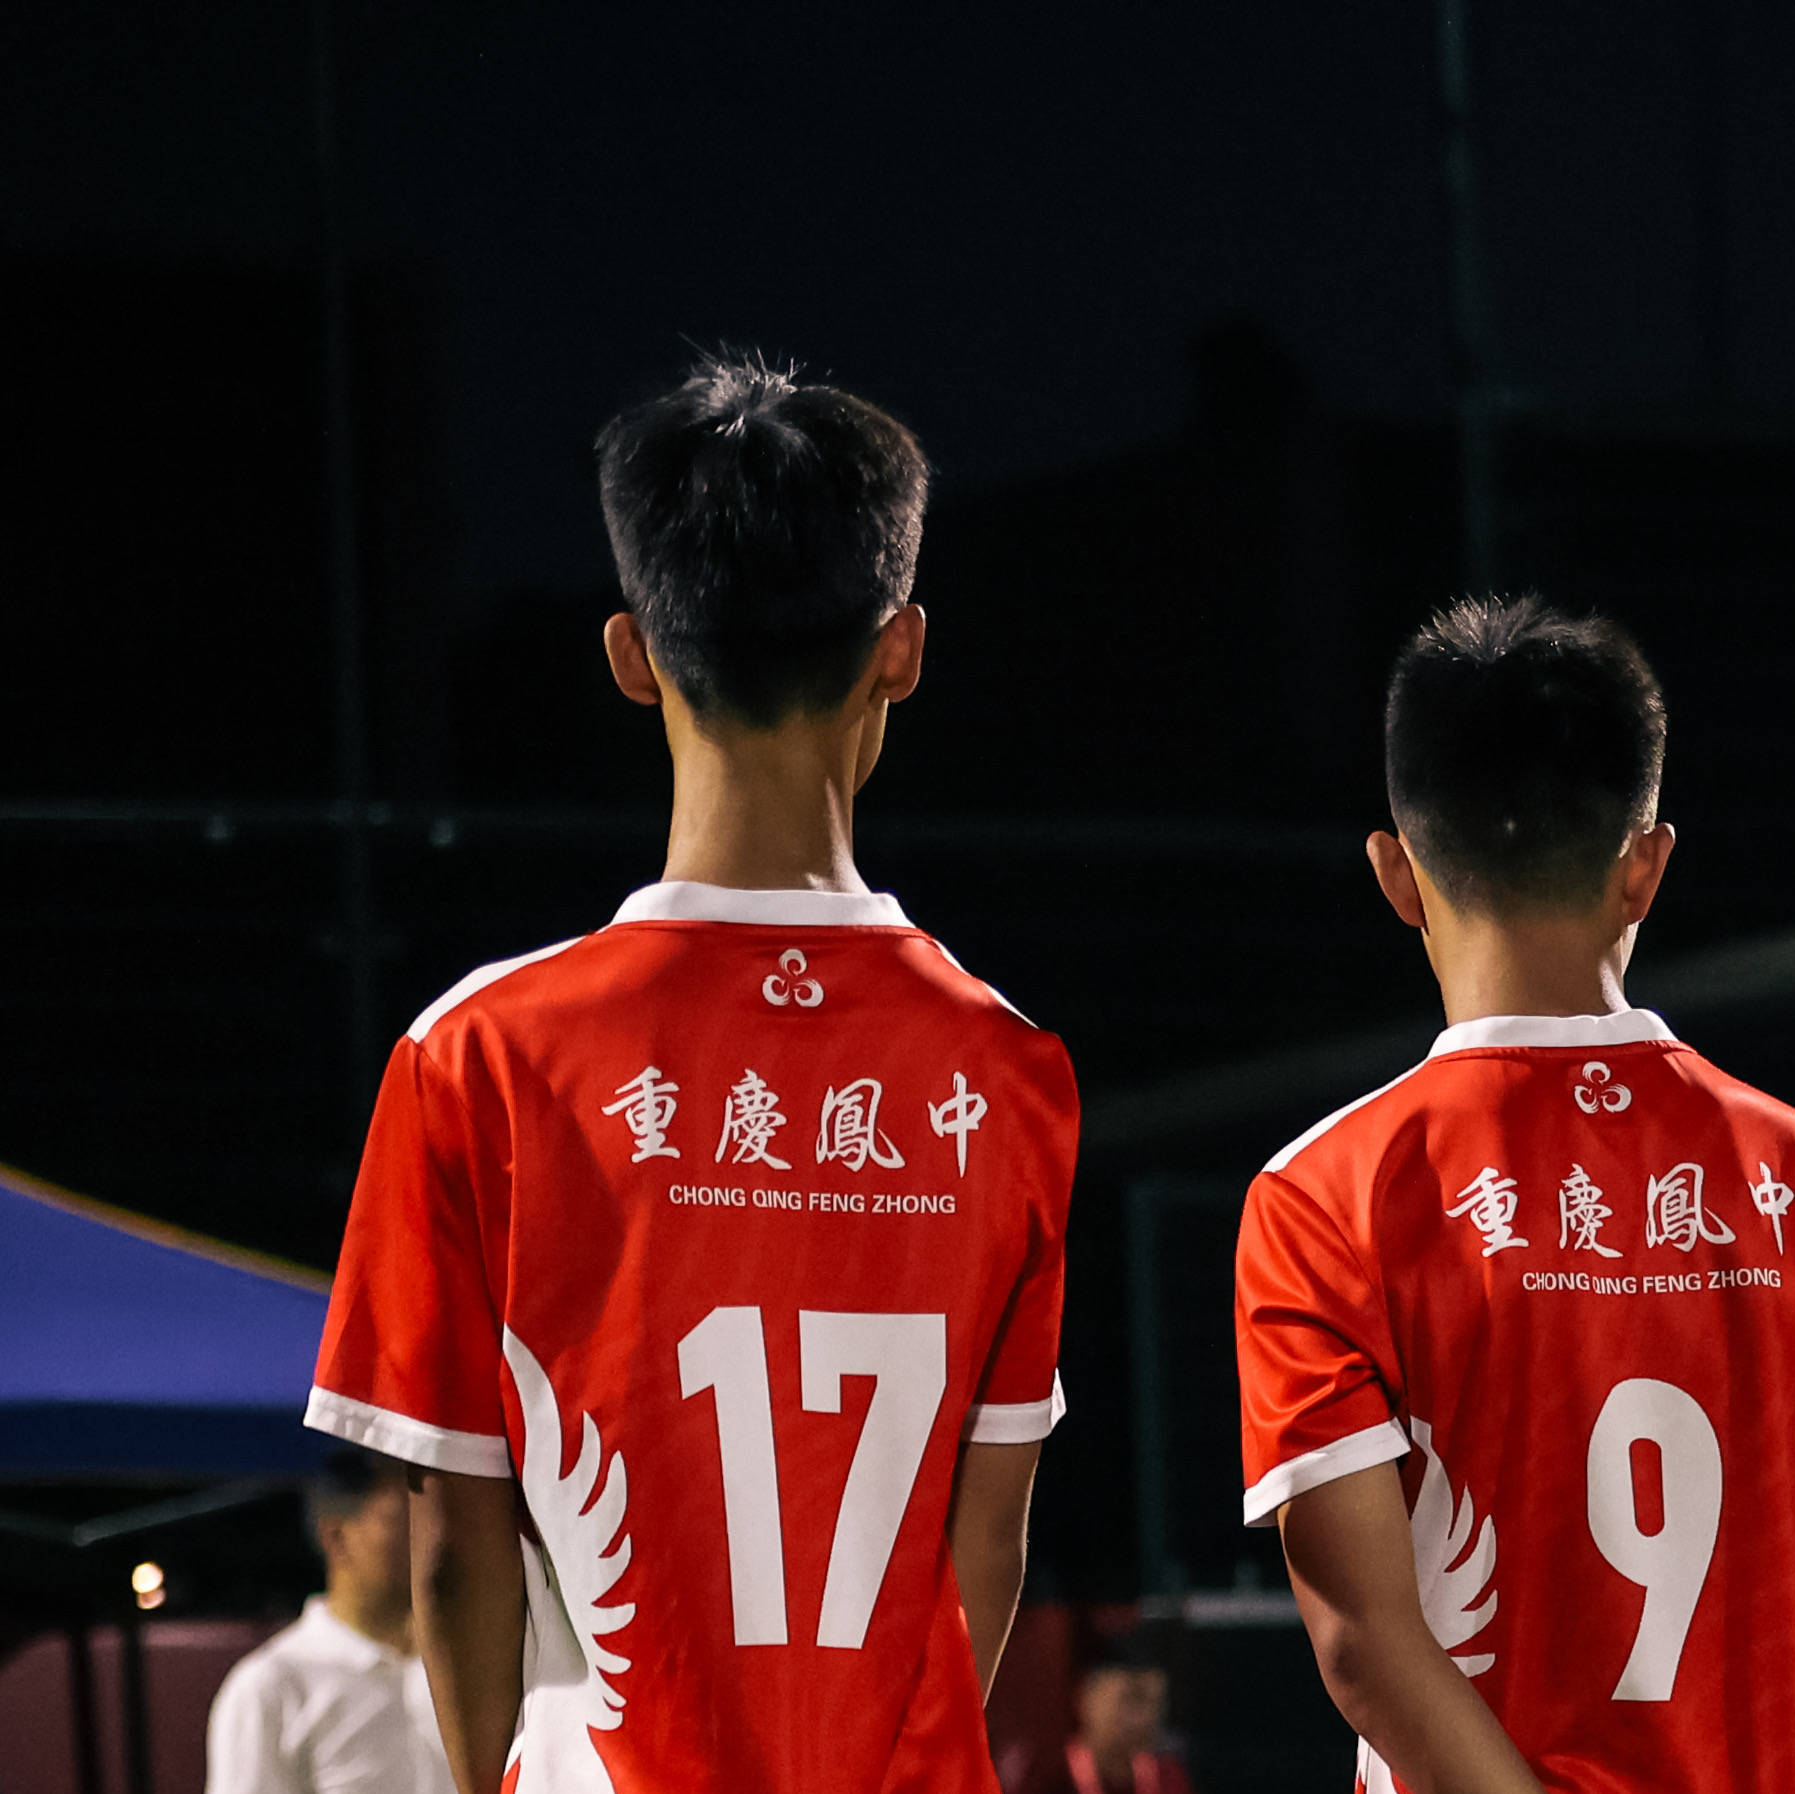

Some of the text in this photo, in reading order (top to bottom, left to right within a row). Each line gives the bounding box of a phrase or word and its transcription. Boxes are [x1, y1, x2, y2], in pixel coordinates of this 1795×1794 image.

[602, 1066, 987, 1177] 重慶鳳中
[669, 1185, 956, 1214] CHONG QING FENG ZHONG
[1445, 1162, 1795, 1257] 重慶鳳中
[1522, 1267, 1781, 1294] CHONG QING FENG ZHONG
[678, 1306, 946, 1649] 17
[1587, 1378, 1722, 1701] 9
